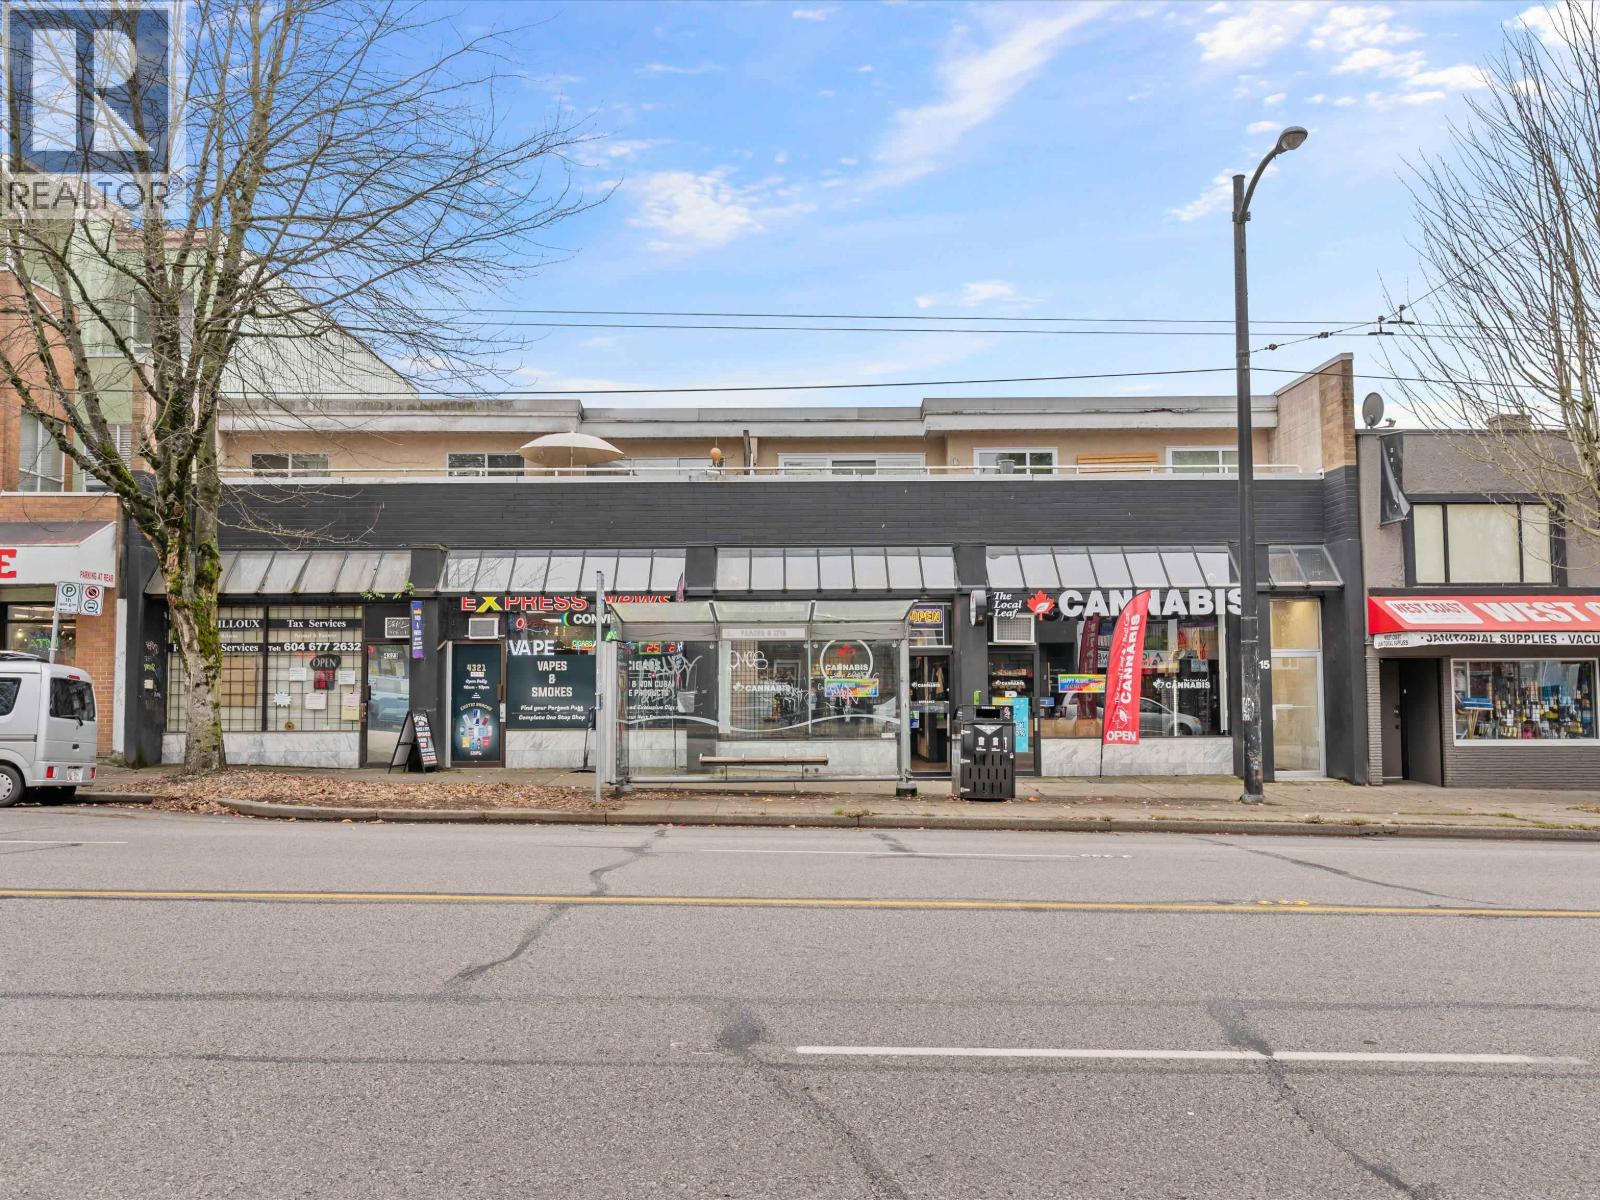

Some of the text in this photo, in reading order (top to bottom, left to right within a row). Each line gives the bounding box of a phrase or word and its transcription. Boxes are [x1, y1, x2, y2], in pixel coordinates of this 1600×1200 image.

[0, 548, 17, 579] E
[80, 570, 114, 583] PARKING AT REAR
[993, 591, 1012, 600] The
[461, 596, 588, 613] EXPRESS
[994, 600, 1022, 610] Local
[1390, 602, 1468, 614] WEST COAST
[910, 610, 942, 622] OPEN
[994, 608, 1018, 620] Leaf
[1473, 601, 1592, 622] WEST
[286, 619, 347, 628] Tax Services
[1500, 633, 1557, 644] SUPPLIES
[1568, 634, 1600, 644] VACU
[221, 643, 259, 652] Services
[283, 642, 305, 651] 604
[308, 642, 332, 651] 677
[334, 642, 361, 651] 2632
[508, 639, 555, 656] VAPE
[312, 656, 337, 668] OPEN
[1120, 614, 1140, 704] CANNABIS
[466, 664, 487, 672] 4321
[537, 661, 568, 671] VAPES
[825, 663, 869, 671] CANNABIS
[1259, 660, 1271, 670] 15
[548, 674, 556, 684] &
[745, 684, 792, 692] CANNABIS
[1165, 681, 1211, 689] CANNABIS
[531, 687, 573, 697] SMOKES
[1106, 730, 1137, 741] OPEN
